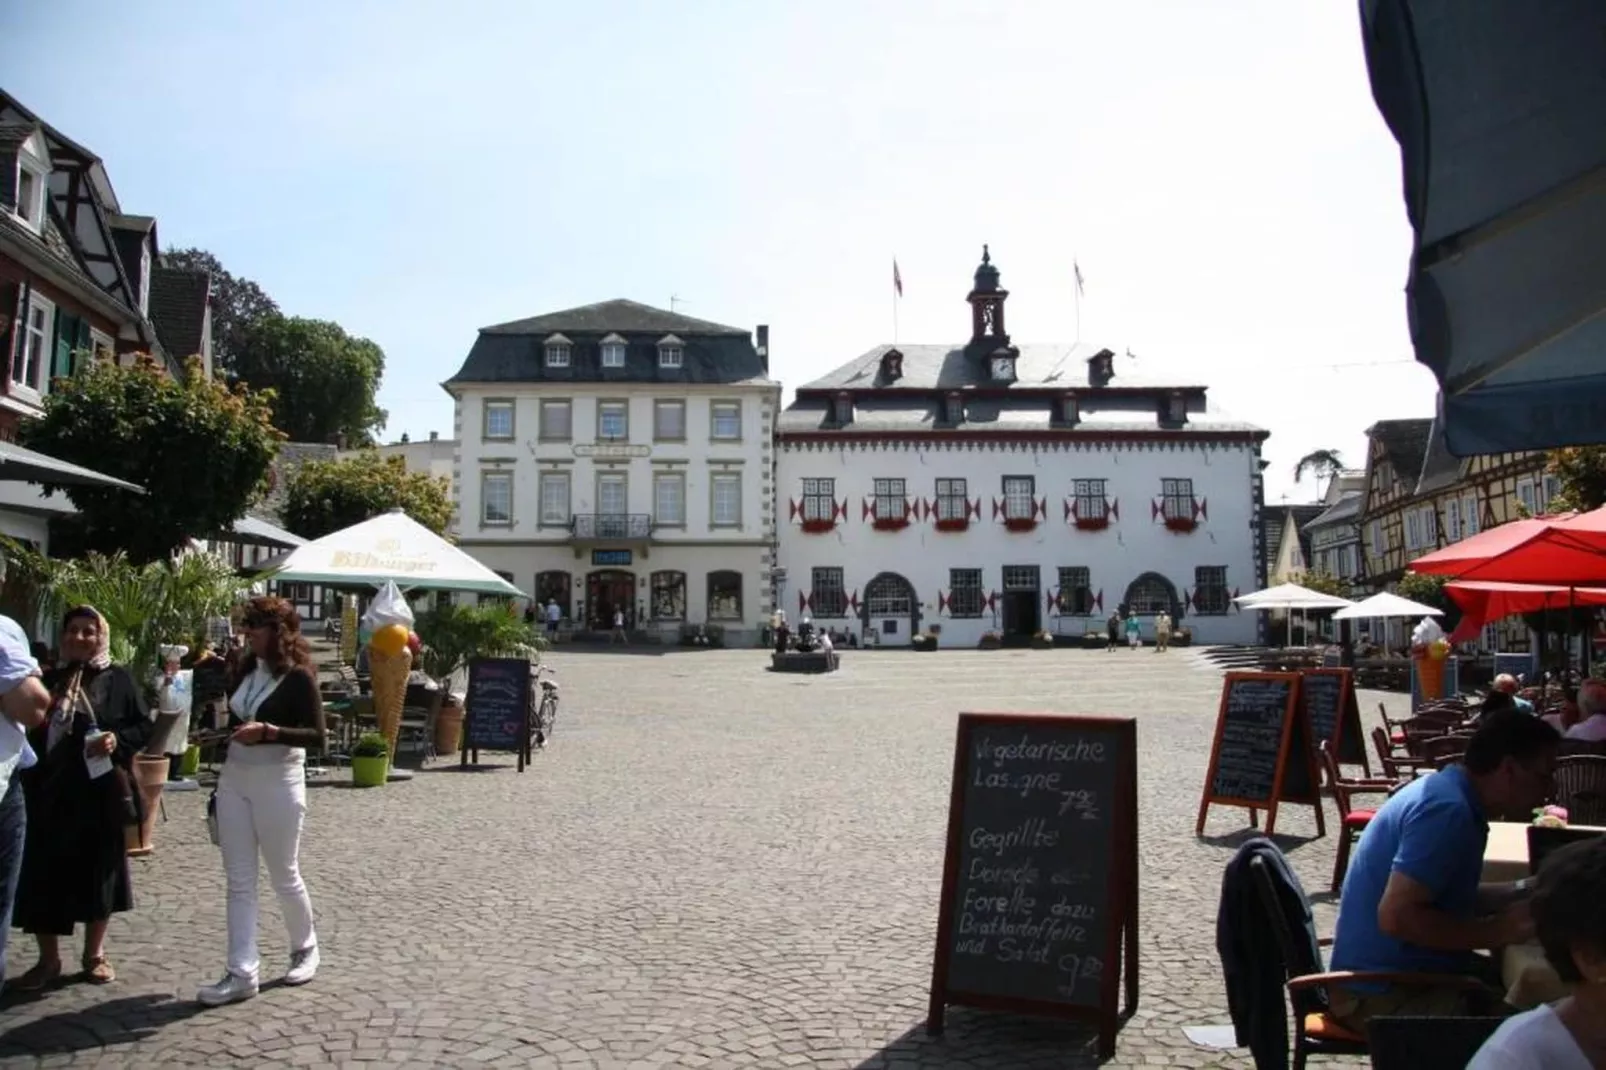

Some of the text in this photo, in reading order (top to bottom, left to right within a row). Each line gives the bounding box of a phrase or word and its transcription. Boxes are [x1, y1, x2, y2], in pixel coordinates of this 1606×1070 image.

[973, 766, 1061, 797] Lasgne
[963, 886, 1037, 914] Forelle
[955, 938, 985, 954] und
